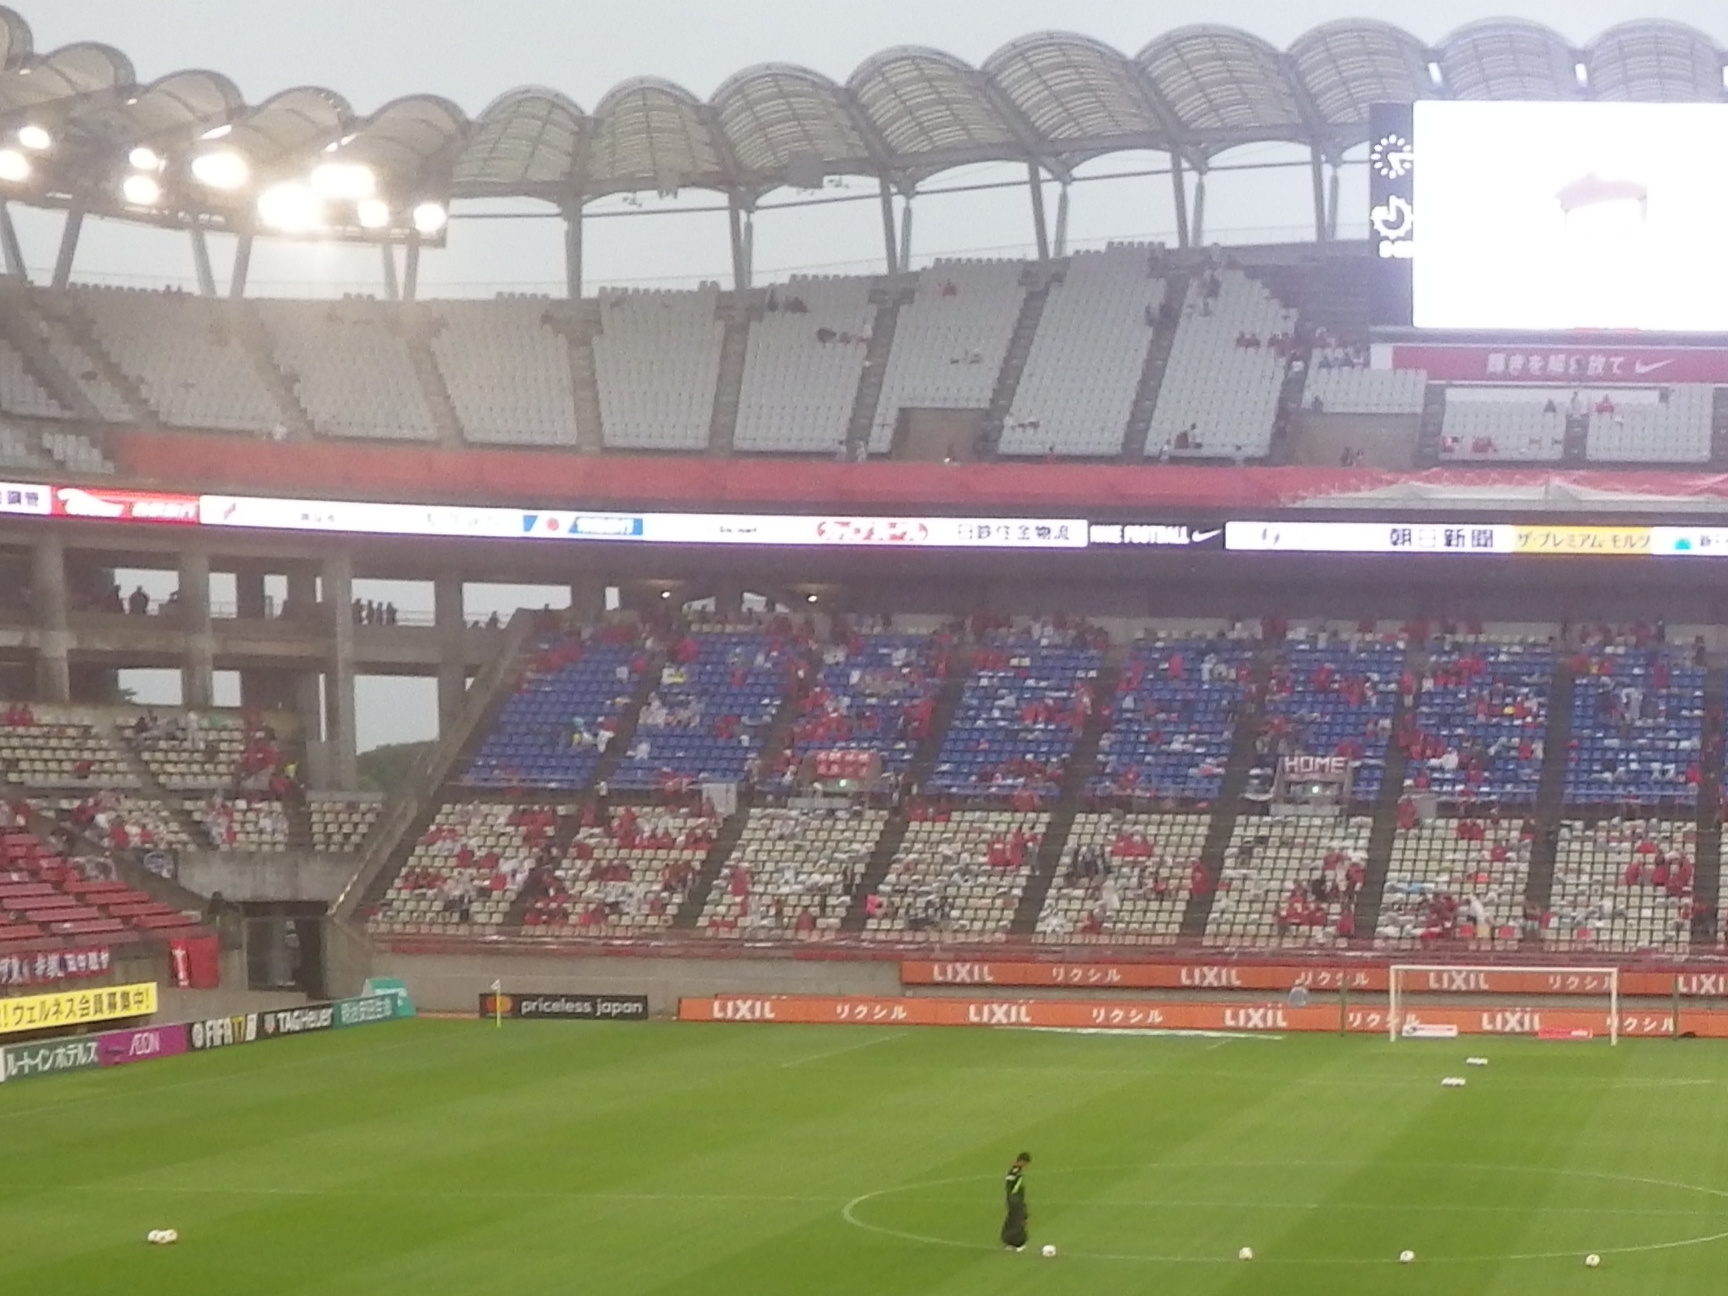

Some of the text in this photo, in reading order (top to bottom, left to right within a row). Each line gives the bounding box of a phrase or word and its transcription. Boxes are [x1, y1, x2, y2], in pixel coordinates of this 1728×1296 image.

[1389, 527, 1494, 548] 朝日新聞
[1284, 756, 1346, 773] HOME
[932, 963, 994, 983] LIXIL
[1052, 966, 1122, 984] リクシル
[1180, 966, 1242, 986] LIXIL
[1427, 970, 1490, 991] LIXIL
[520, 997, 644, 1017] priceless japan
[712, 999, 776, 1020] LIXIL
[835, 1003, 907, 1021] リクシル
[968, 1002, 1032, 1023] LIXIL
[1092, 1007, 1163, 1024] リクシル
[1224, 1008, 1288, 1028] LIXIL
[205, 1018, 232, 1048] FIFA
